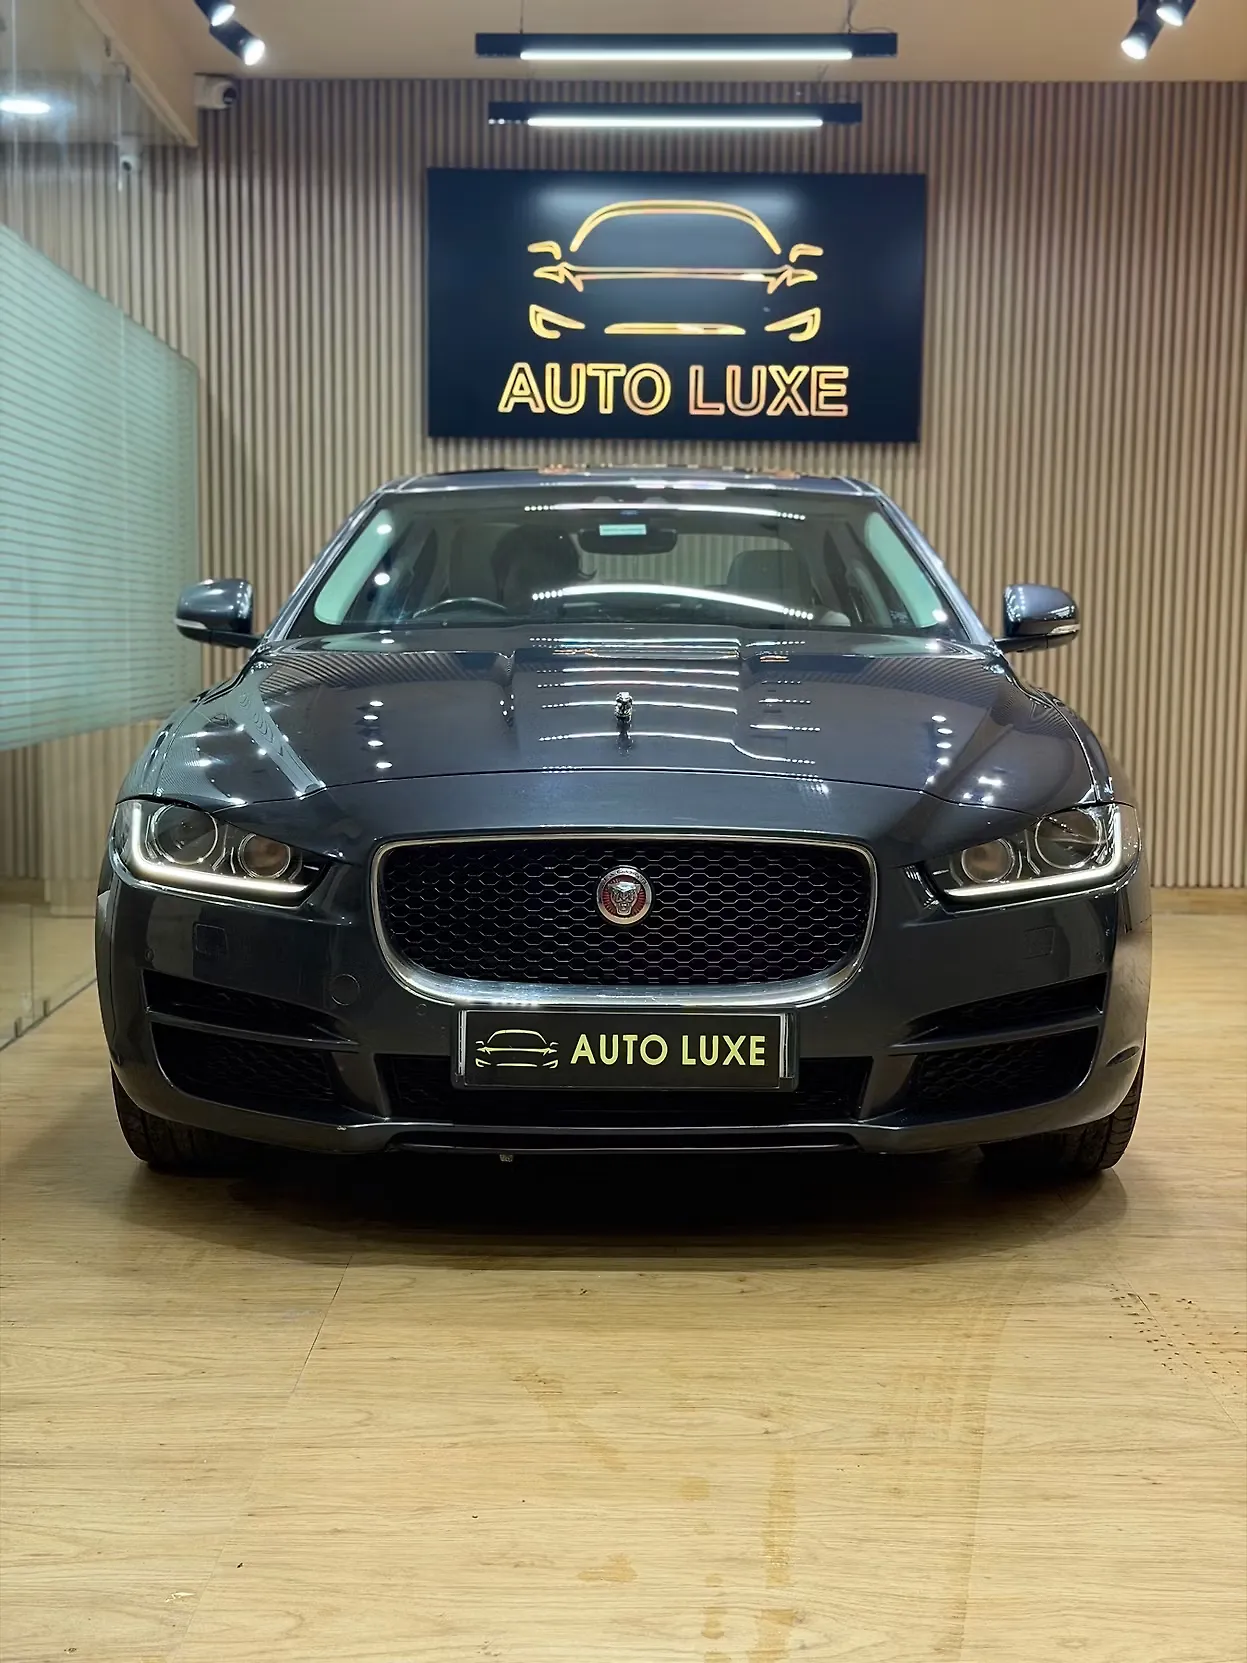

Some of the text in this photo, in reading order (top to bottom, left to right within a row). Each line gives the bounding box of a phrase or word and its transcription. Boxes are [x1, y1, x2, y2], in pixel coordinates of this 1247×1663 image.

[498, 362, 849, 417] AUTO LUXE
[570, 1034, 766, 1066] AUTO LUXE
